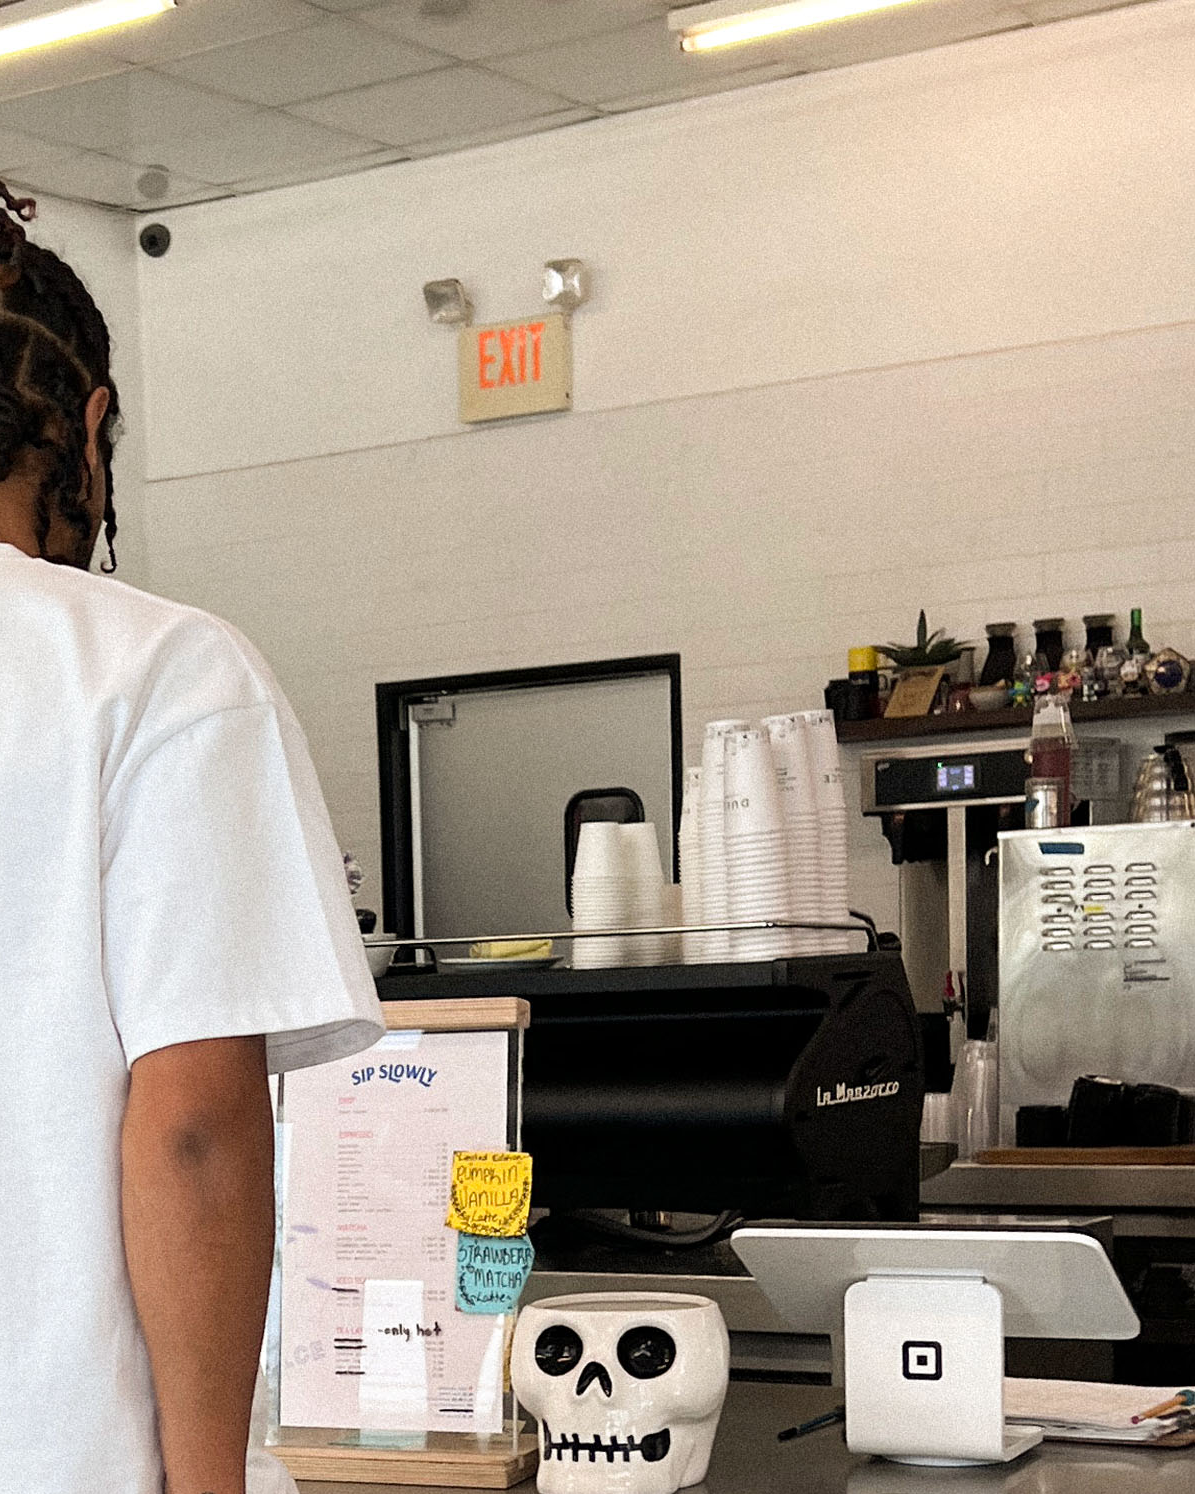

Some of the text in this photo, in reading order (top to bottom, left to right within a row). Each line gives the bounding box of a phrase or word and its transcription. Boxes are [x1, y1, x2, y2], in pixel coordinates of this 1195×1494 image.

[478, 322, 545, 389] EXIT
[351, 1064, 438, 1087] SIP SLOWLY
[474, 1267, 522, 1289] MATCHA
[416, 1320, 442, 1337] hot
